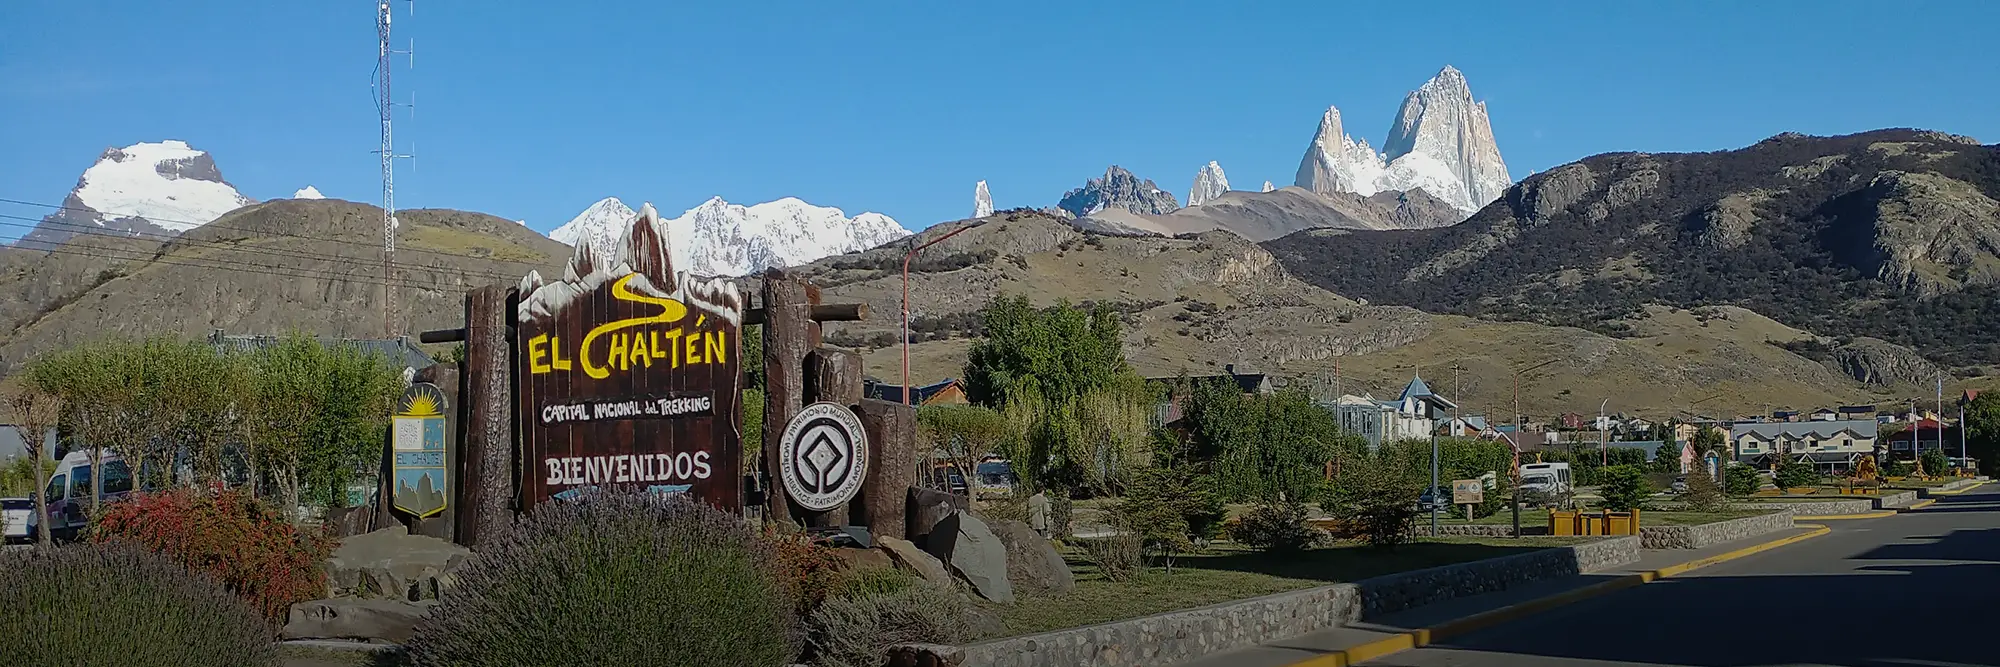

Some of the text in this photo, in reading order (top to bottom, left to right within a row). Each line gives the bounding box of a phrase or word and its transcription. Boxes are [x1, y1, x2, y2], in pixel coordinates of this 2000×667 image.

[529, 272, 726, 379] EL CHALTÉN
[542, 404, 590, 423] CAPITAL
[594, 401, 641, 419] NACIONAL
[657, 397, 711, 415] TREKKING
[789, 406, 859, 437] PATRIMONIO MUNDIAL
[397, 453, 407, 464] EL
[545, 451, 711, 485] BIENVENIDOS
[783, 442, 811, 504] WORLD HERITAGE
[814, 439, 864, 506] PATRIMOINE MONDIAL
